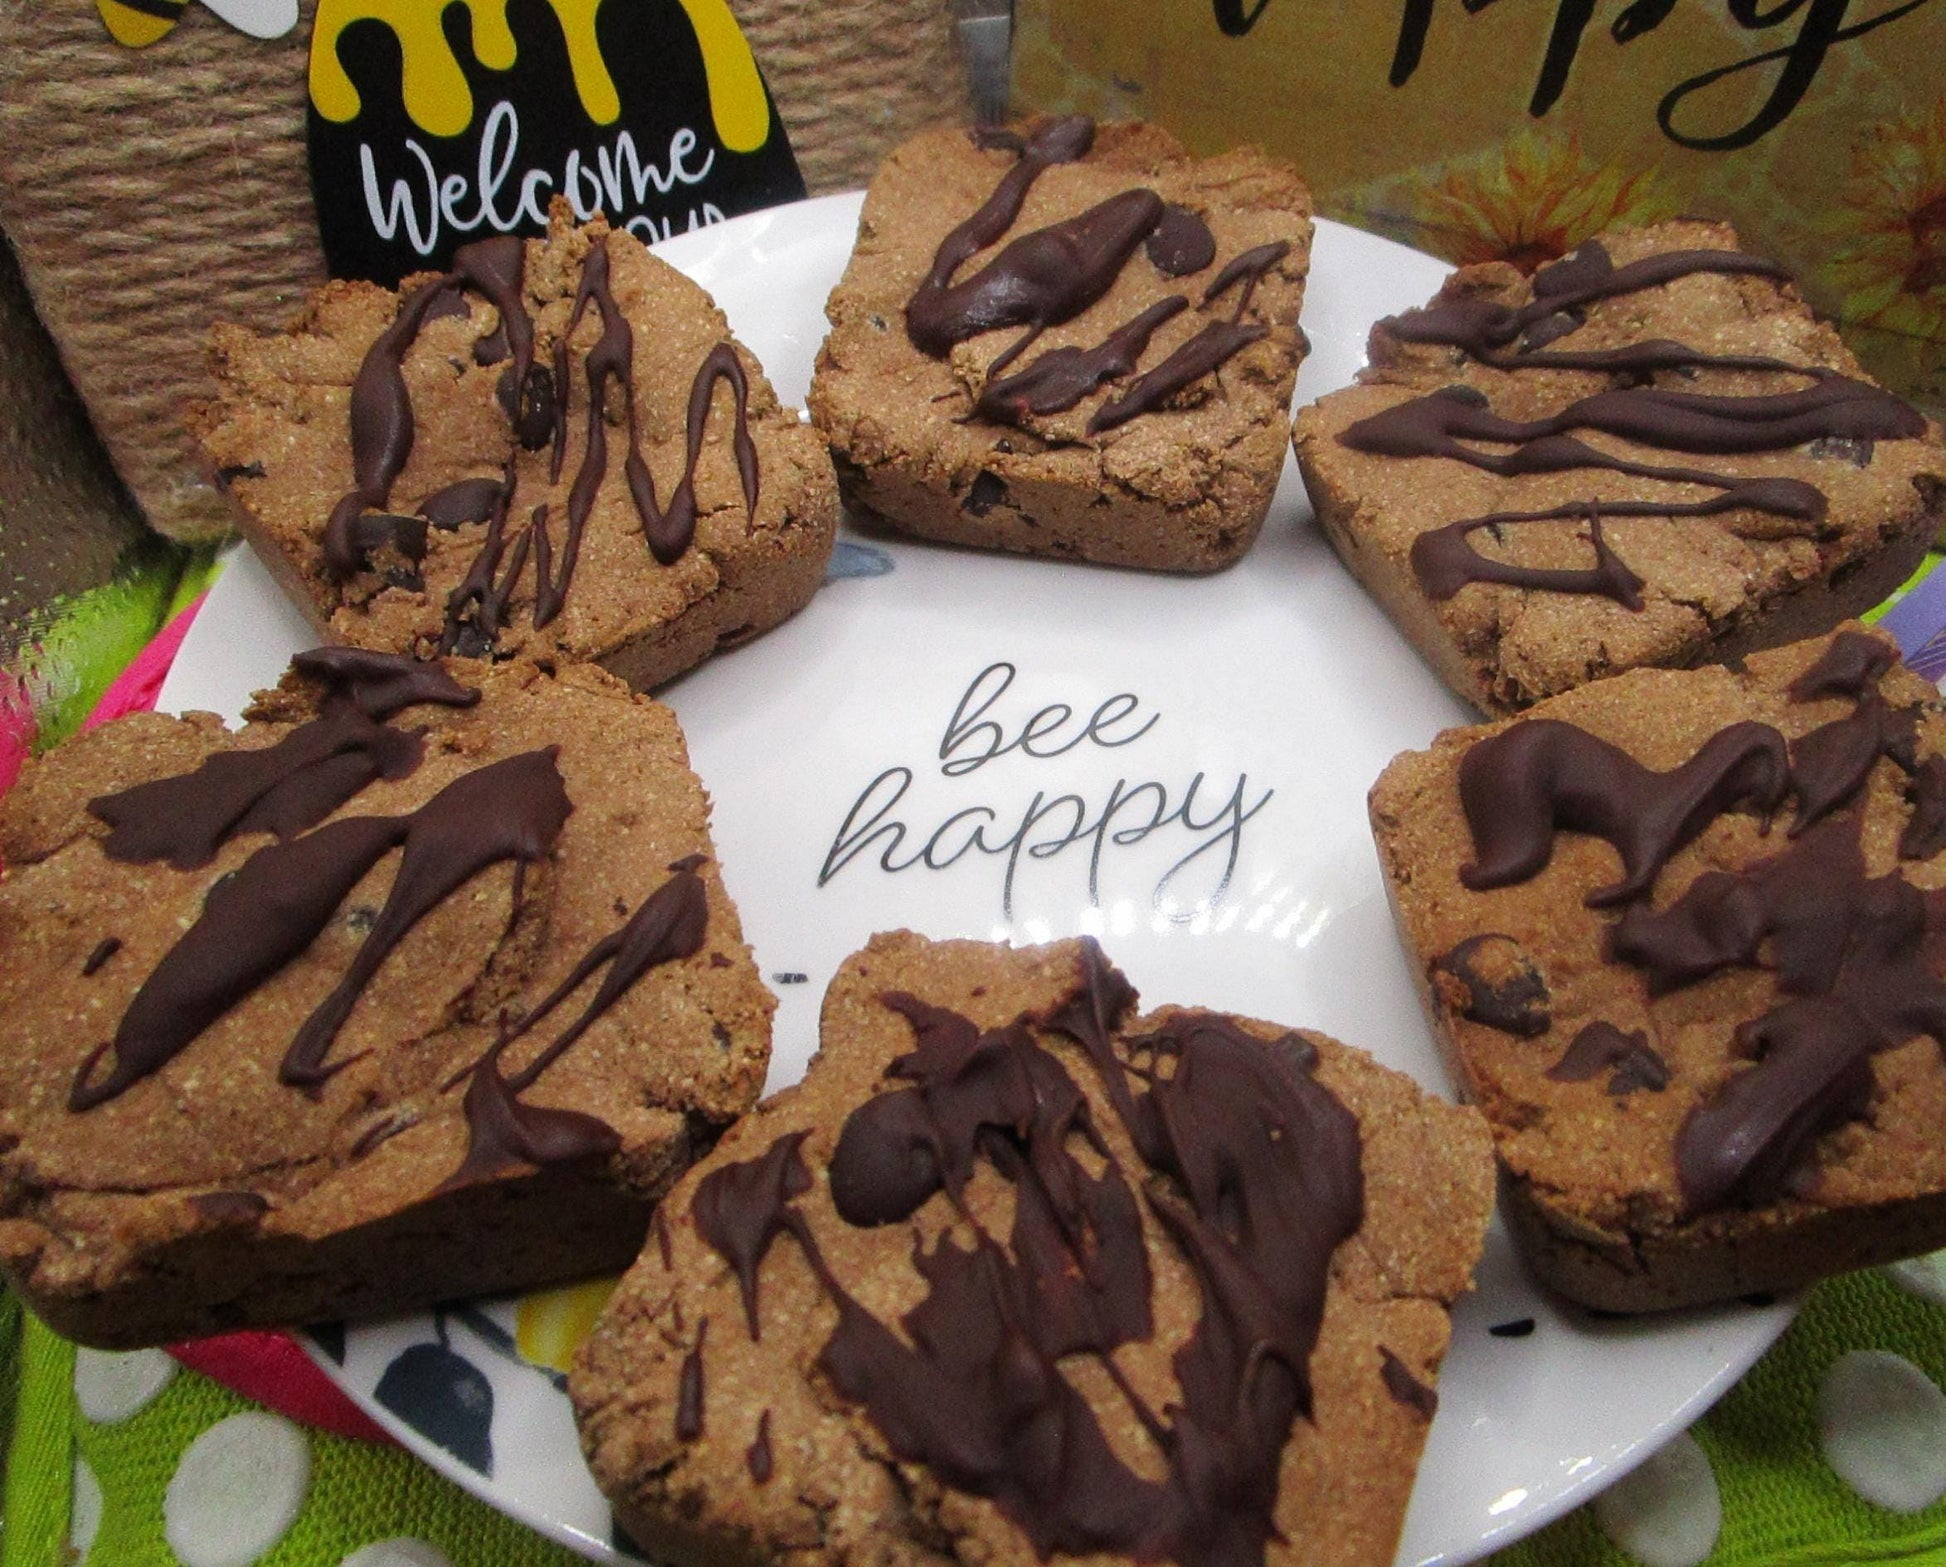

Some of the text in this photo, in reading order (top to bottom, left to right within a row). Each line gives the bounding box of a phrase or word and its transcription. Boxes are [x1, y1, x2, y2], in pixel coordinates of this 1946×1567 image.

[360, 101, 715, 255] Welcome
[939, 662, 1161, 776] bee
[816, 766, 1274, 923] happy
